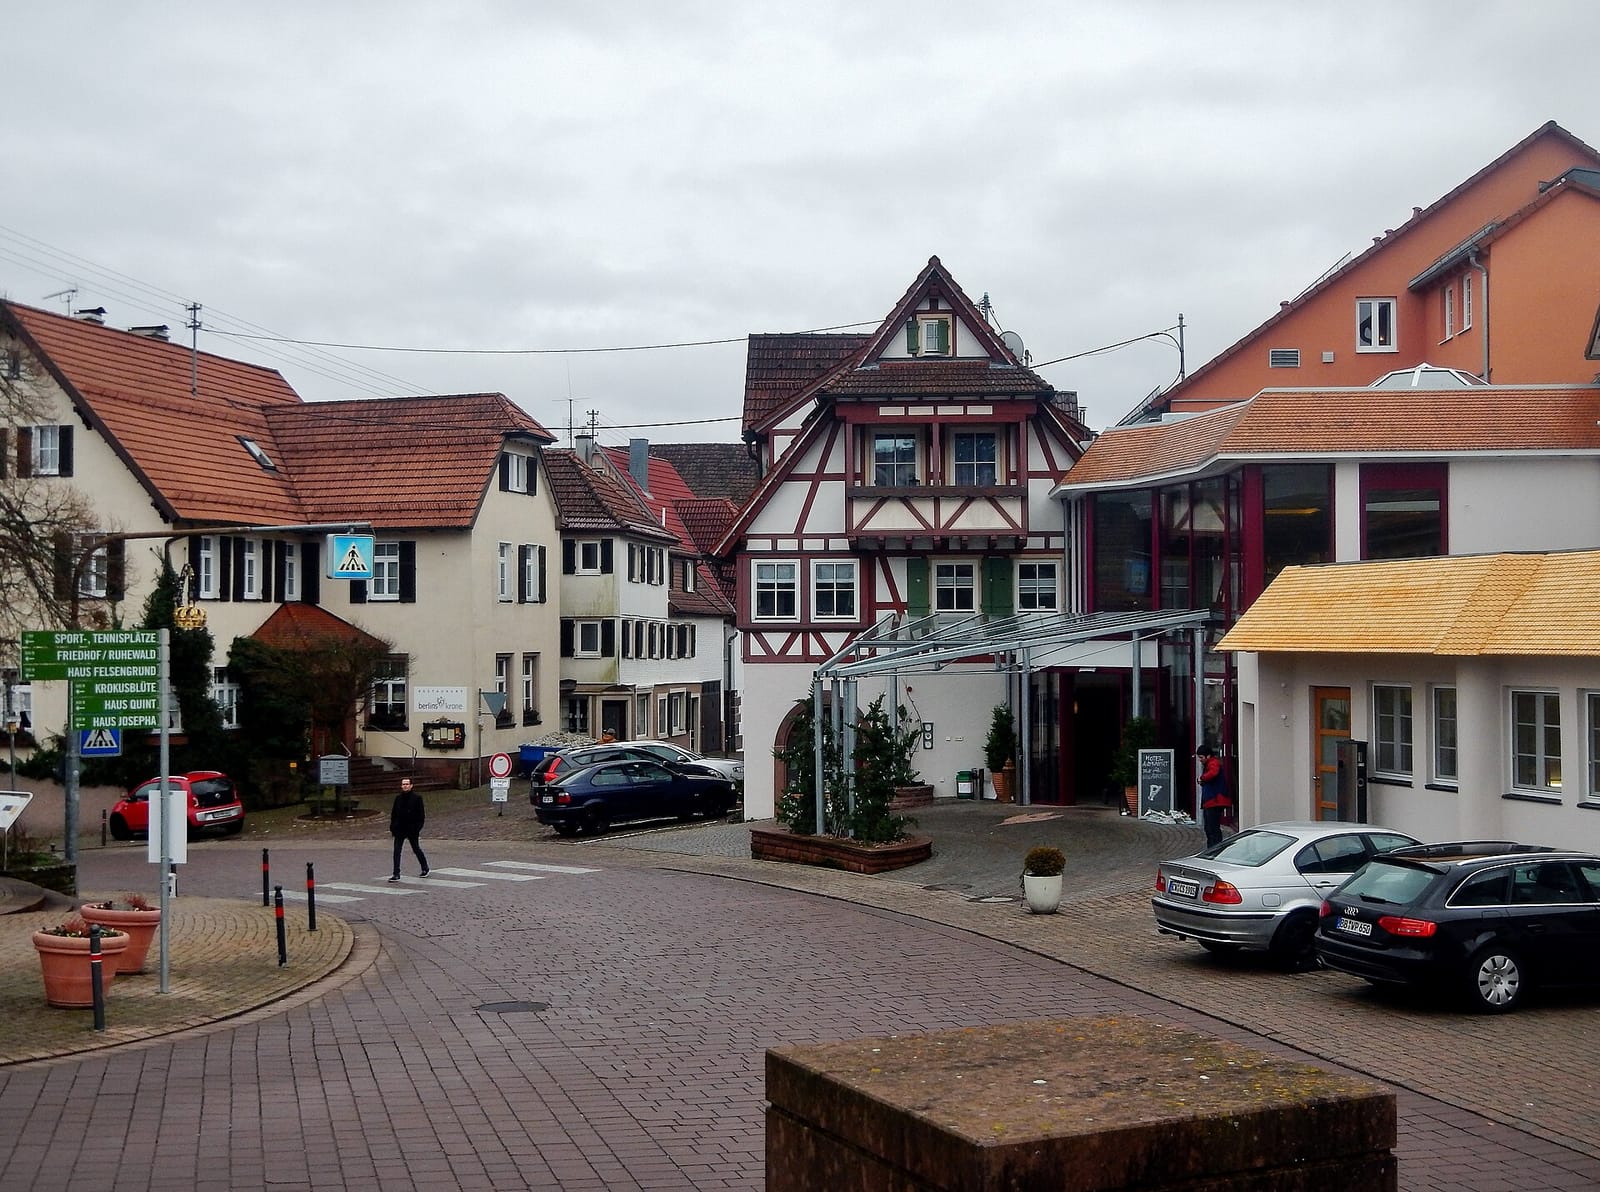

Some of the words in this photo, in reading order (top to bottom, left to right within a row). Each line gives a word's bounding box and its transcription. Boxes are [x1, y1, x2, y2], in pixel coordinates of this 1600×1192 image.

[54, 633, 91, 645] SPORT-,
[93, 632, 156, 644] TENNISPLÄTZE
[57, 650, 102, 661] FRIEDHOF
[109, 649, 156, 660] RUHEWALD
[67, 667, 92, 677] HAUS
[94, 666, 157, 677] FELSENGRUND
[95, 681, 157, 694] KROKUSBLÜTE
[104, 700, 128, 710] HAUS
[130, 699, 156, 710] QUINT
[445, 702, 464, 710] krone
[93, 716, 116, 727] HAUS
[118, 715, 157, 727] JOSEPHA
